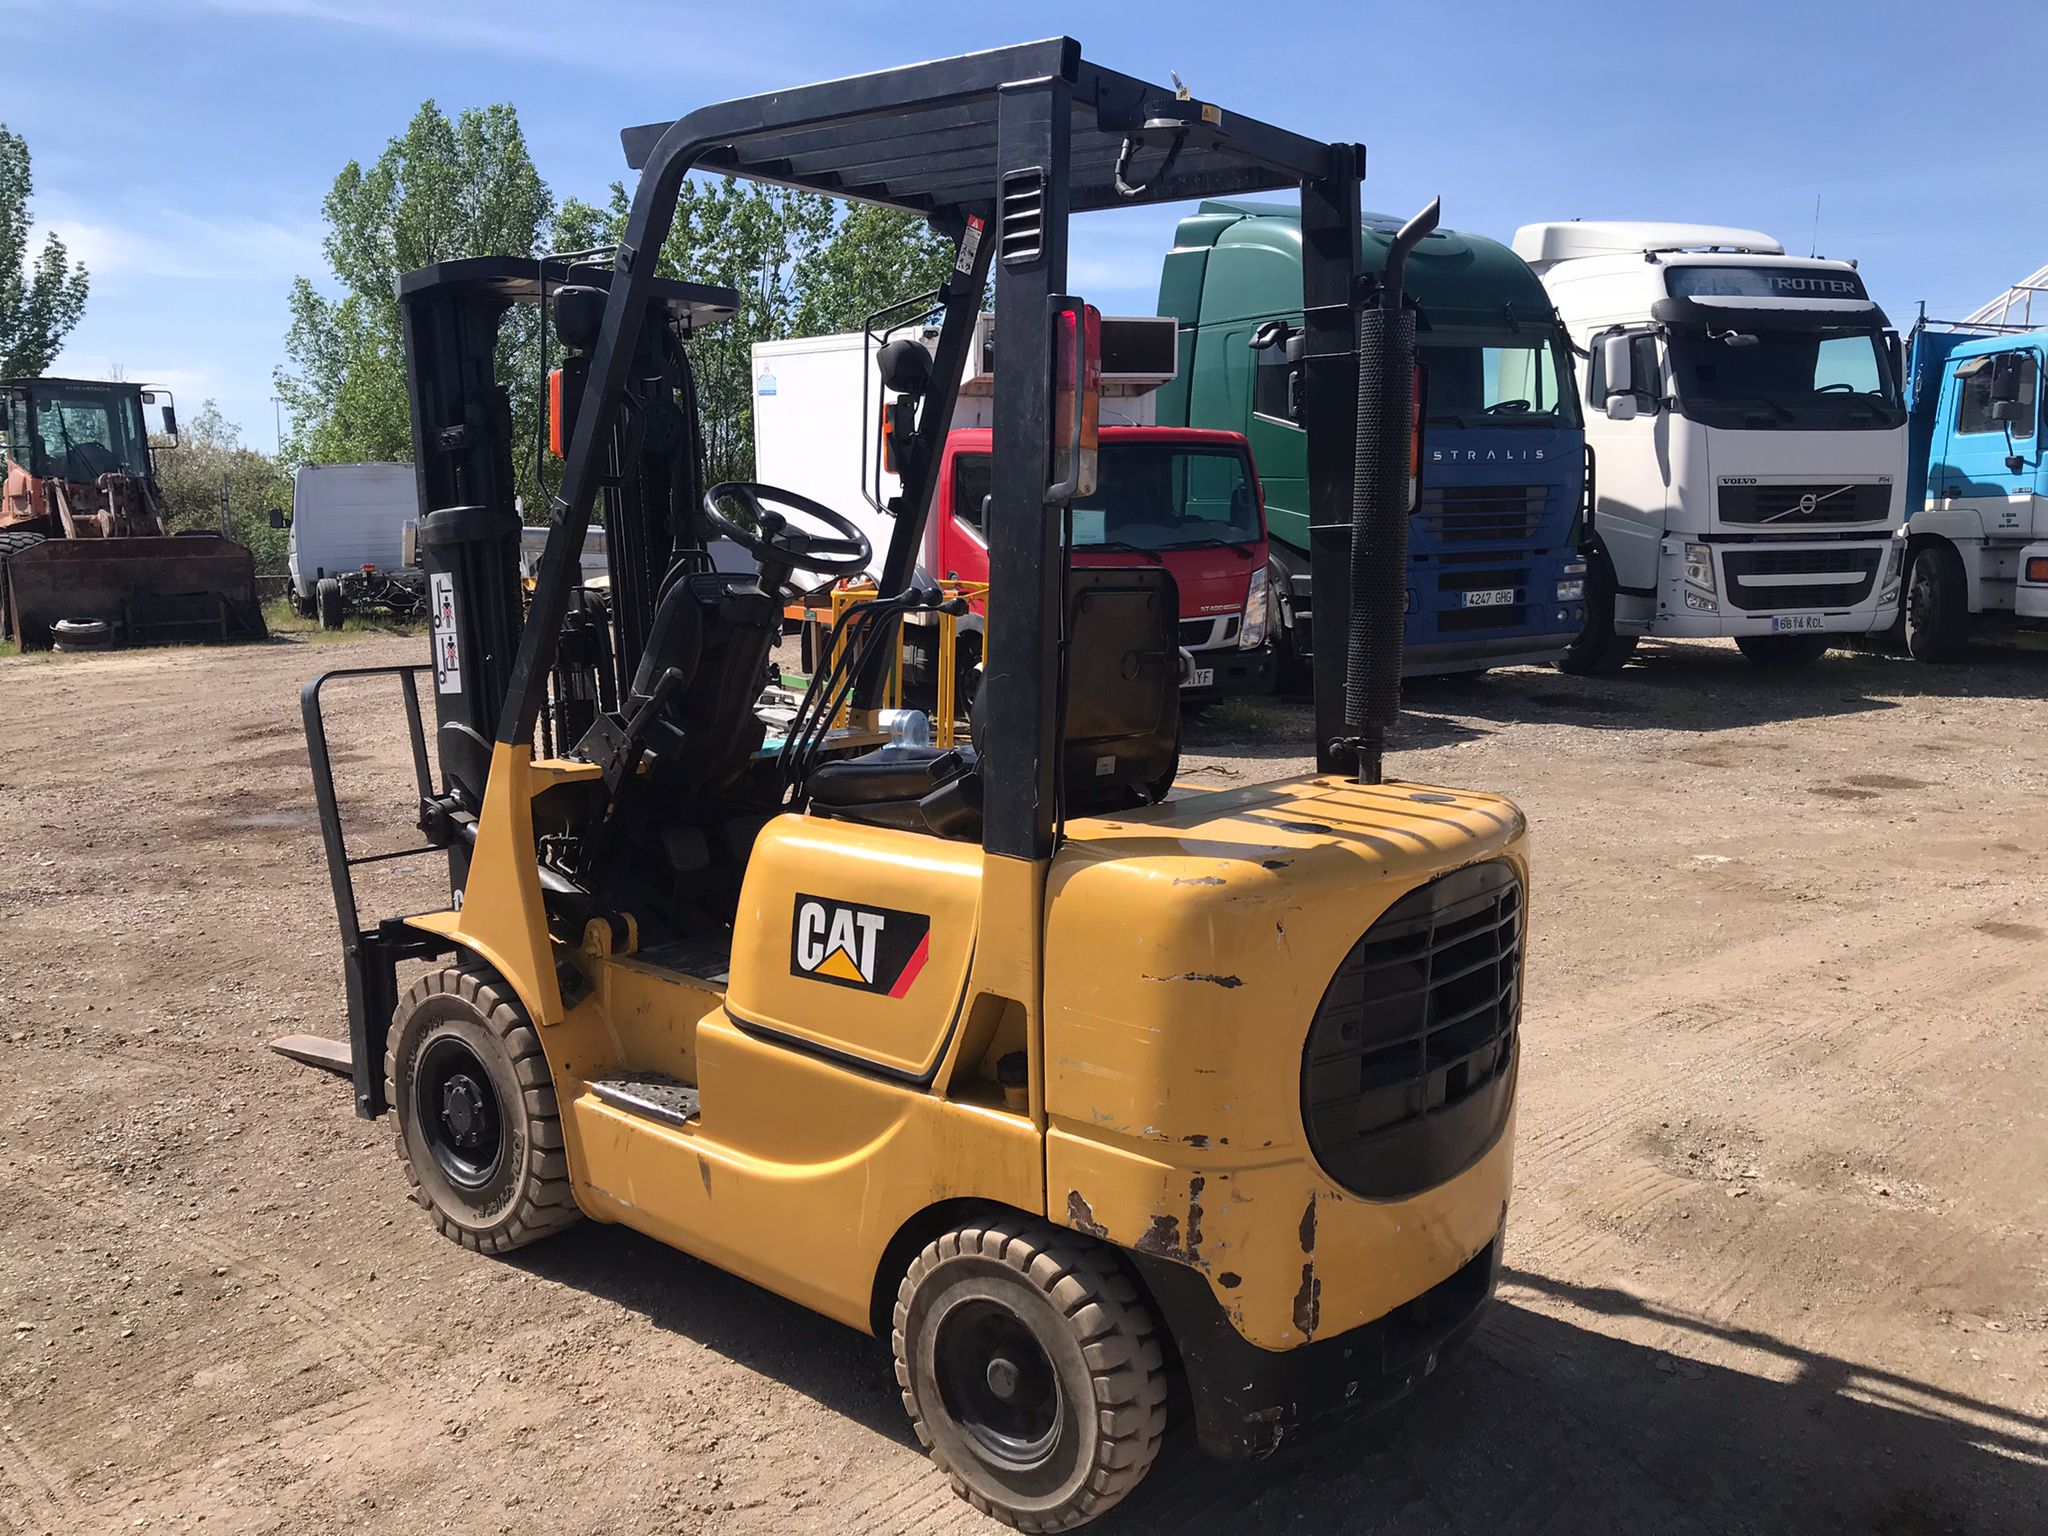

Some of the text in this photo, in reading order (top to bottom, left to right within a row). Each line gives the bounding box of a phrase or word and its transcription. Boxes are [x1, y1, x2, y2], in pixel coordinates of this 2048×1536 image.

[1433, 449, 1544, 461] STRALIS
[1722, 477, 1757, 485] VOLVO
[1469, 590, 1512, 606] 4247 GHG
[1780, 615, 1825, 630] 6814 KCL
[797, 901, 885, 985] CAT
